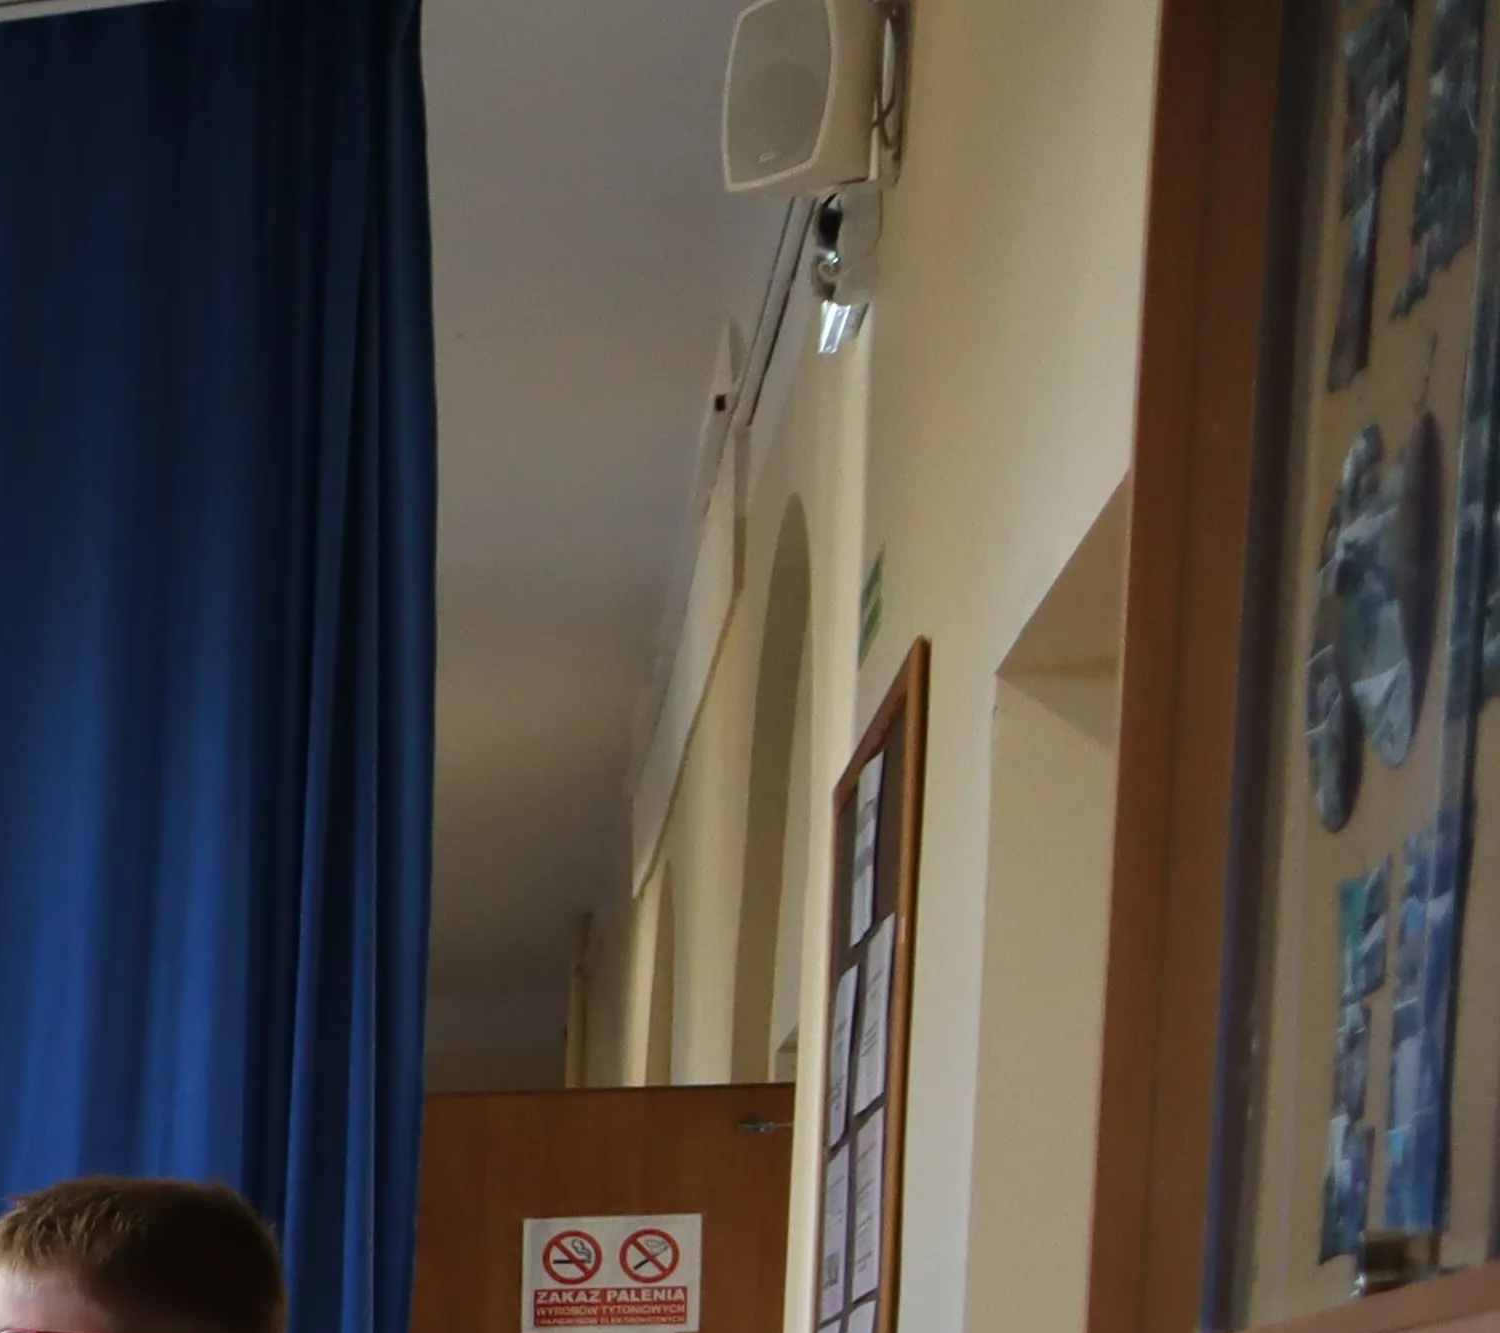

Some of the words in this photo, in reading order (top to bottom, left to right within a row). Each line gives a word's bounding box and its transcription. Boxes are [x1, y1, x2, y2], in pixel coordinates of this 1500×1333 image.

[536, 1290, 601, 1304] ZAKAZ
[606, 1288, 686, 1303] PALENIA
[602, 1303, 686, 1315] TYTONIOWYCH
